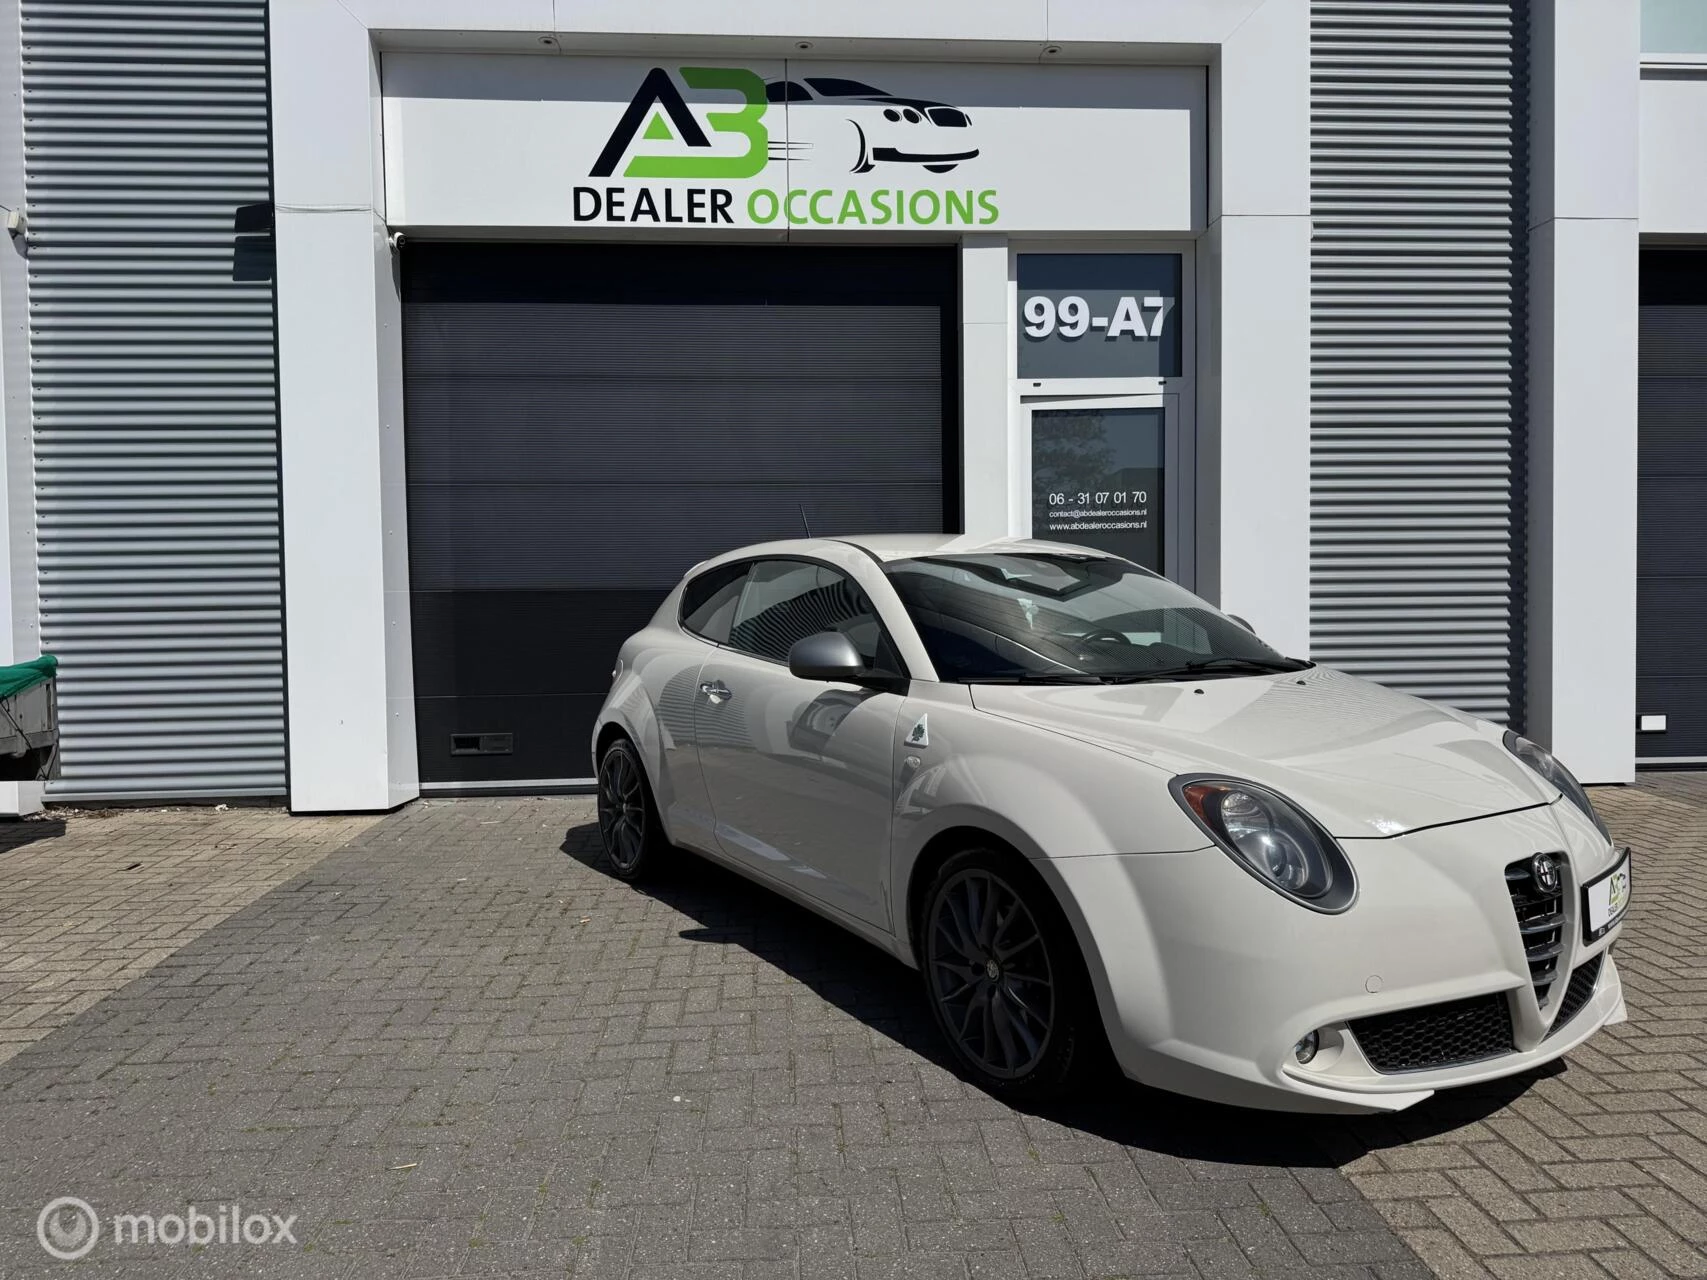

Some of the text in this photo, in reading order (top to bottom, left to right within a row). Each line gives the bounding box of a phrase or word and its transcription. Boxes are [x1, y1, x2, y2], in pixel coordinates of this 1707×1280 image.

[573, 186, 1000, 225] DEALER OCCASIONS
[1023, 295, 1176, 338] 99-A7
[1048, 493, 1065, 505] 06
[1077, 492, 1090, 504] 31
[1095, 492, 1110, 504] 07
[1113, 491, 1127, 504] 01
[1132, 491, 1147, 503] 70
[1049, 509, 1147, 519] contact@abdealeroccasions.nl
[1049, 520, 1147, 531] www.abdealeroccasions.nl
